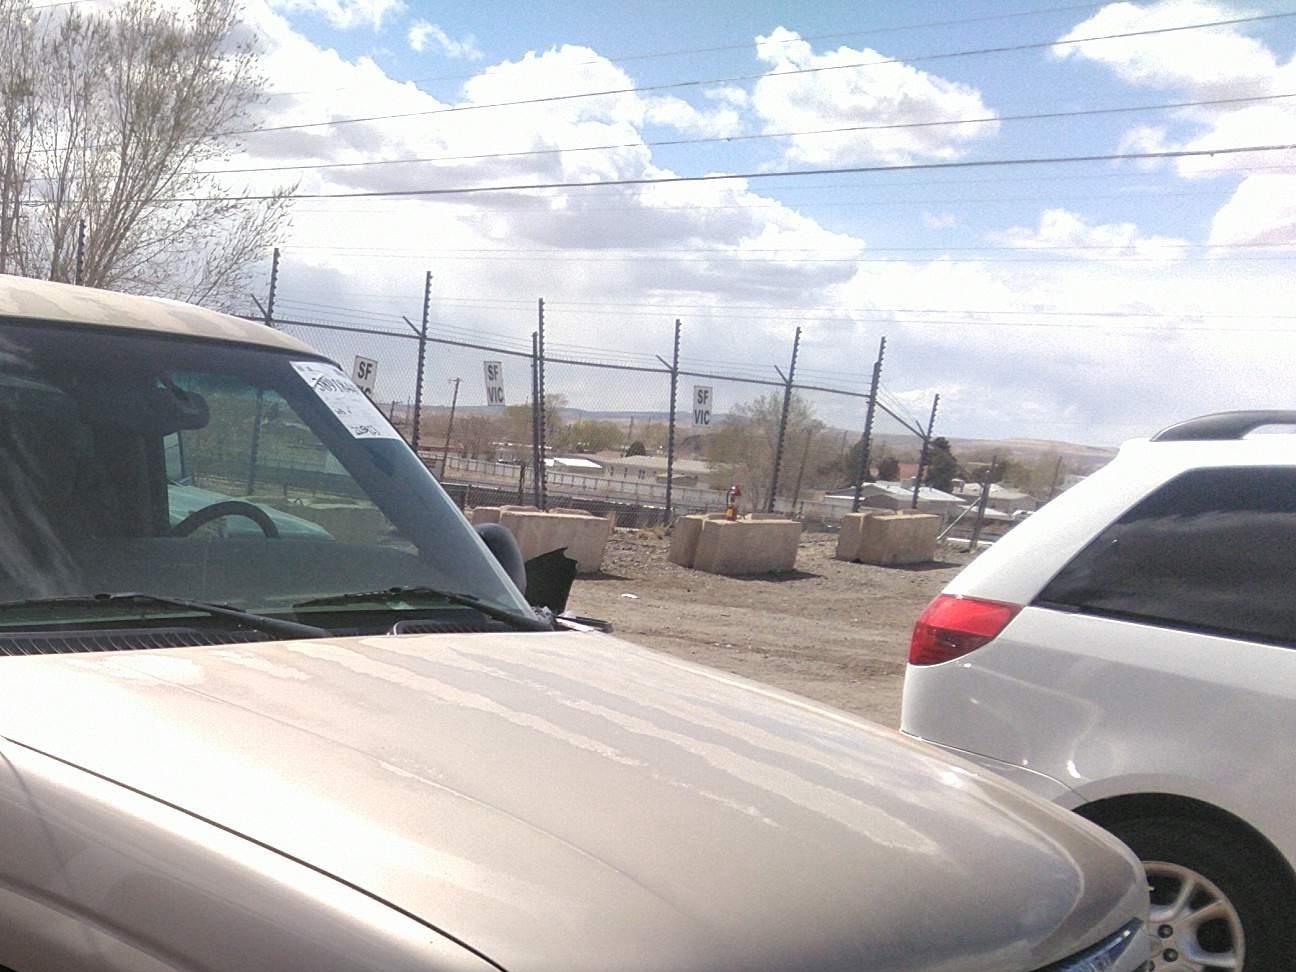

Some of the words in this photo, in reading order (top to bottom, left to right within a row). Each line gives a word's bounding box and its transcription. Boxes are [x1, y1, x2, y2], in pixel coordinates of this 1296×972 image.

[357, 361, 373, 380] SF
[487, 364, 499, 381] SF
[487, 386, 504, 403] VIC
[697, 389, 709, 405] SF
[694, 409, 710, 425] VIC
